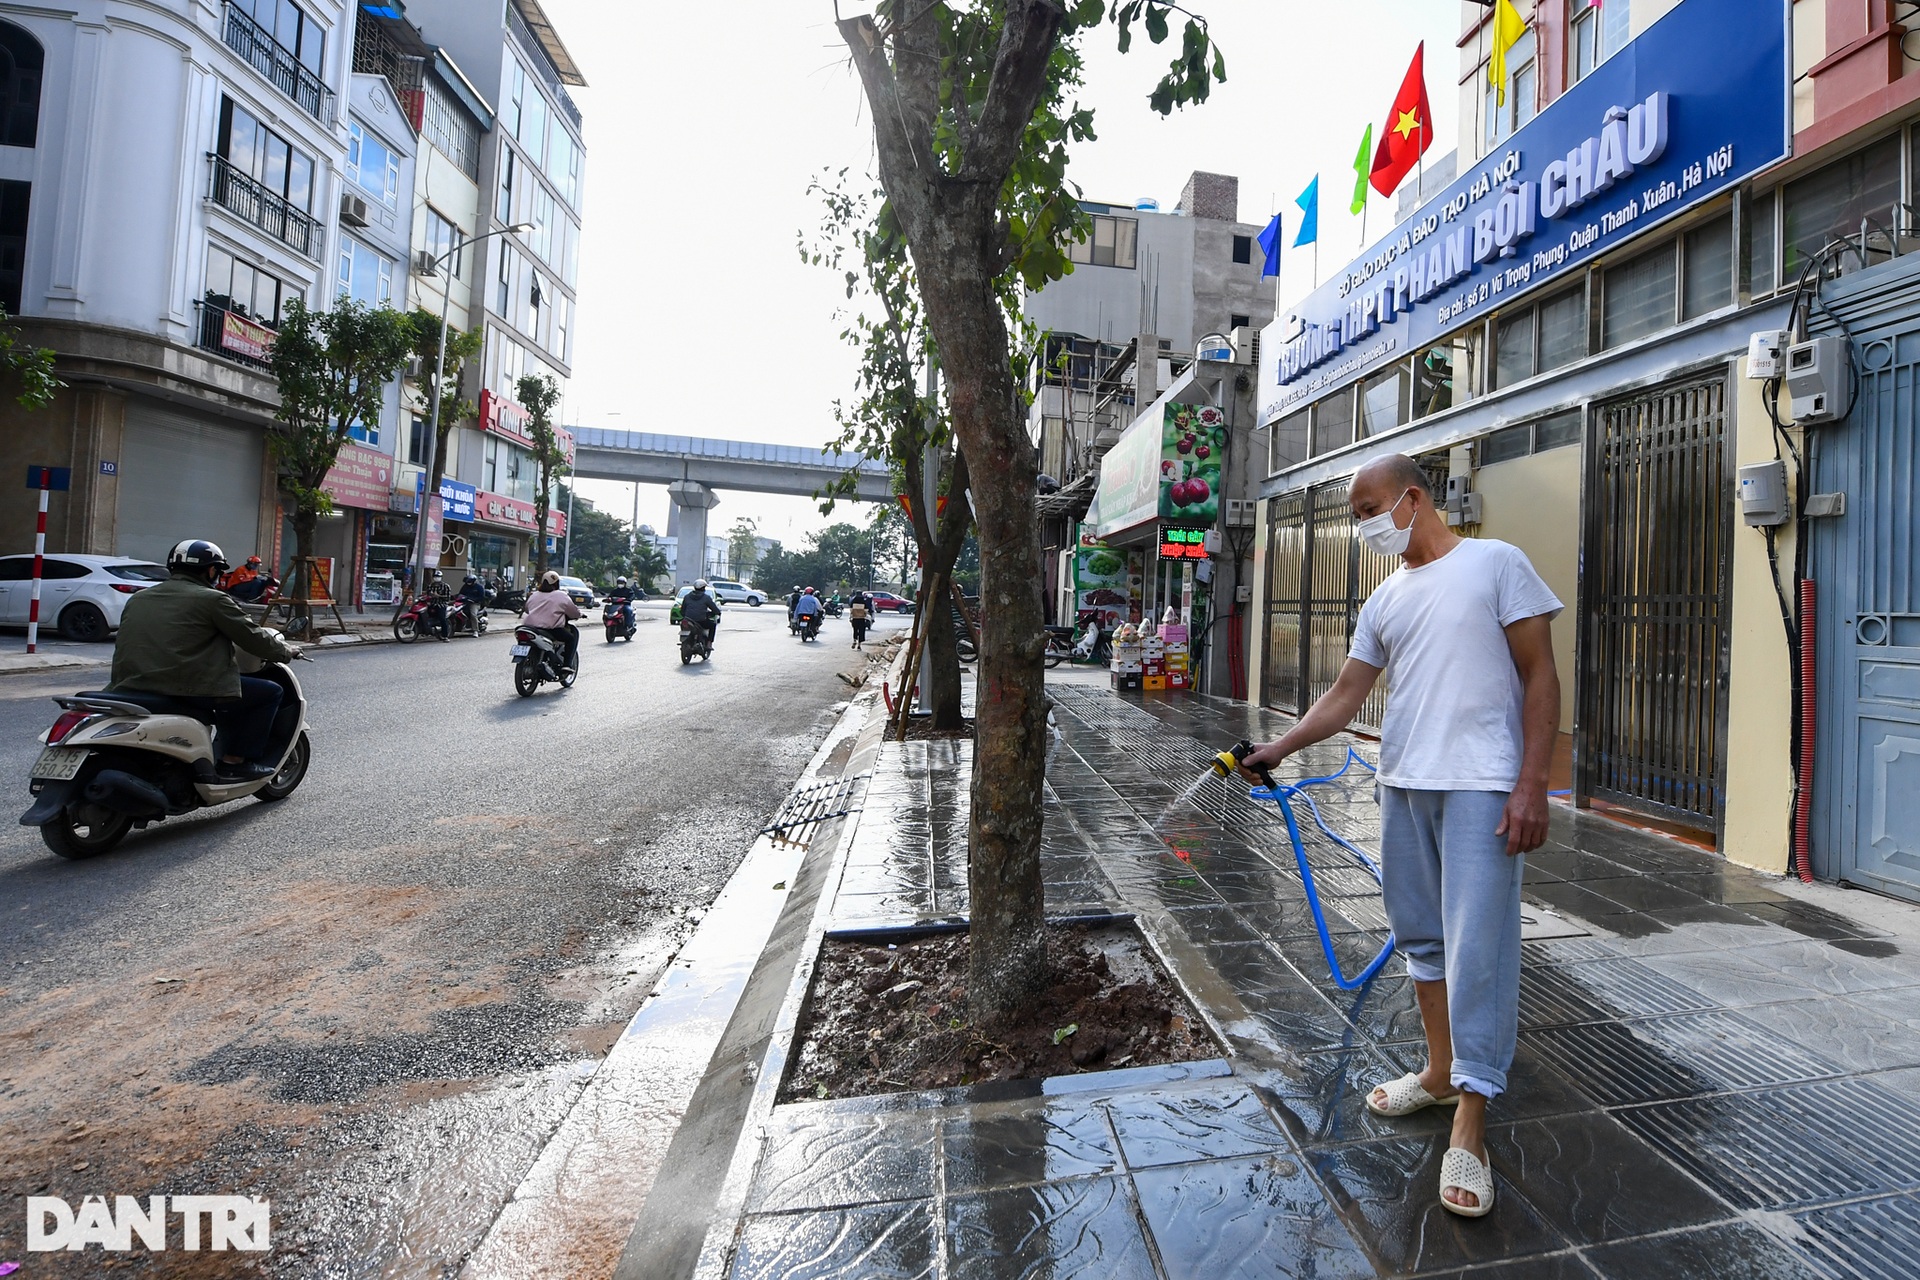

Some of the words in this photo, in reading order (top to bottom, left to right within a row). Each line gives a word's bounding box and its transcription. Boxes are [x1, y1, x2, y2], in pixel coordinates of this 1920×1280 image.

[1341, 280, 1396, 346] THPT
[1394, 226, 1473, 312] PHAN
[1474, 179, 1536, 264] BỘI
[1540, 91, 1669, 220] CHÂU
[1351, 262, 1376, 289] GIÁO
[1374, 245, 1397, 271] DỤC
[1397, 230, 1412, 255] VÀ
[1412, 213, 1439, 246] ĐÀO
[1440, 191, 1468, 224] TẠO
[1470, 172, 1492, 204] HÀ
[1493, 150, 1522, 187] NỘI
[1438, 305, 1451, 325] Địa
[1479, 281, 1489, 303] 21
[1491, 273, 1503, 295] Vũ
[1505, 261, 1531, 289] Trọng
[1569, 220, 1600, 250] Quận
[1600, 198, 1639, 236] Thanh
[1706, 143, 1734, 180] Nội
[102, 462, 115, 472] 10
[373, 456, 391, 470] 9999
[1167, 528, 1187, 542] TRÁI
[1161, 542, 1186, 558] NHẬP
[43, 749, 82, 763] 29-Y5
[32, 763, 77, 778] 350.25
